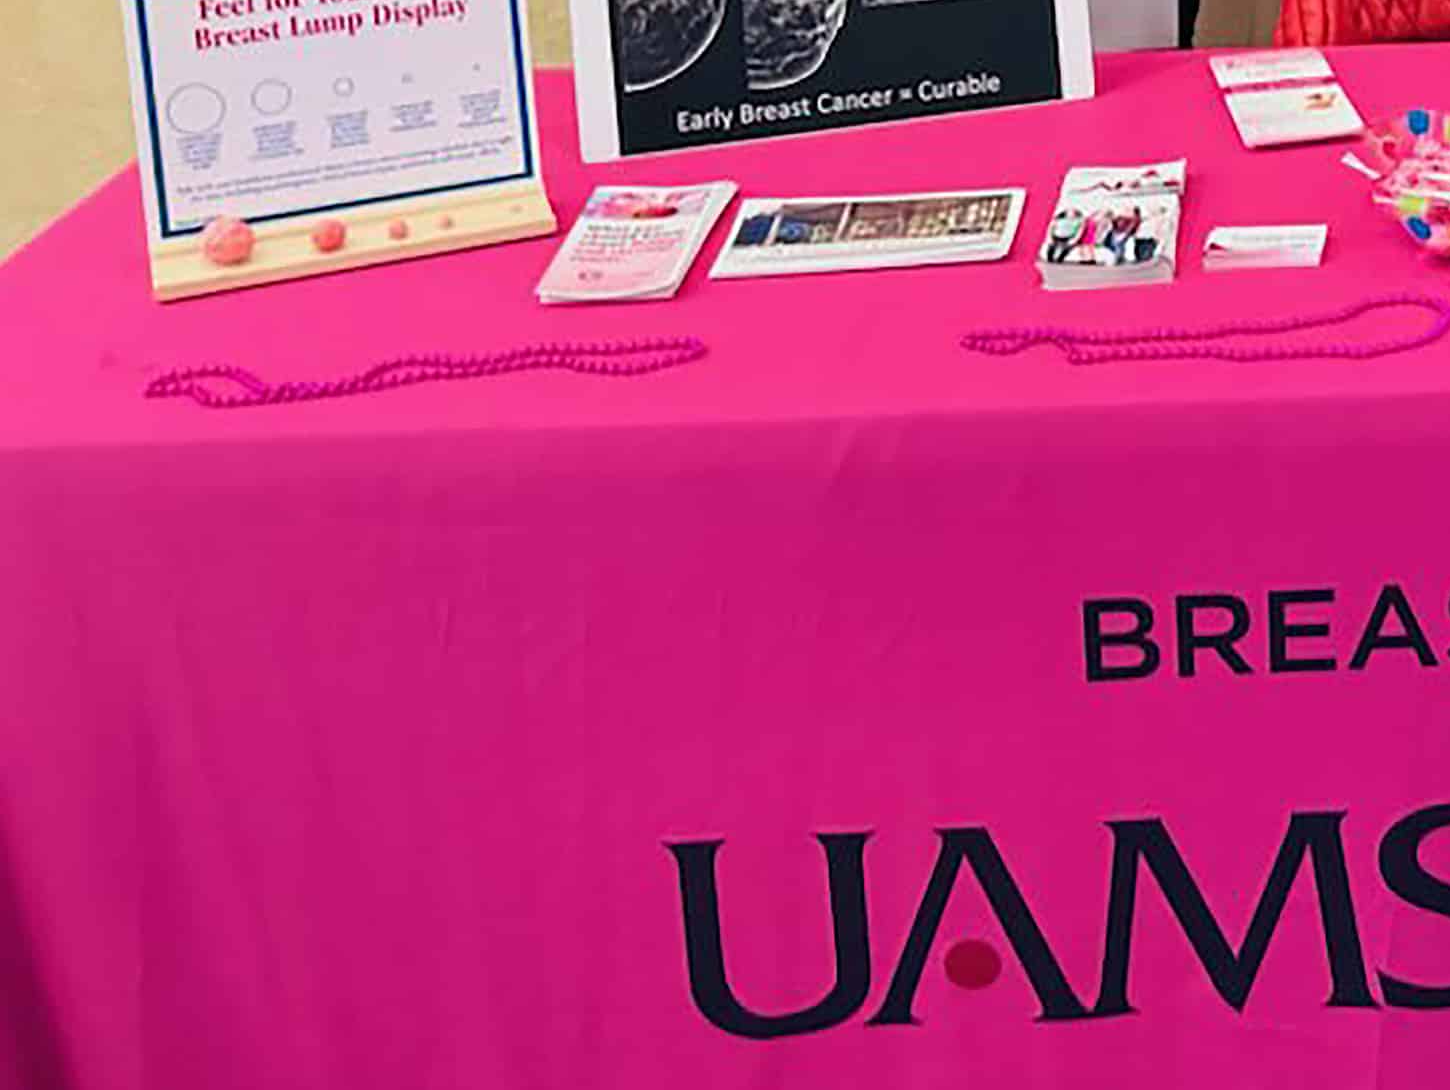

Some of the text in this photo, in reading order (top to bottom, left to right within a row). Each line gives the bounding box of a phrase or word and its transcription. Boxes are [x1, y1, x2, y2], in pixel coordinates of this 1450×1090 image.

[194, 21, 281, 51] Breast
[289, 11, 364, 38] Lump
[676, 106, 734, 133] Early
[739, 97, 811, 126] Breast
[816, 86, 894, 114] Cancer
[917, 72, 1002, 103] Curable
